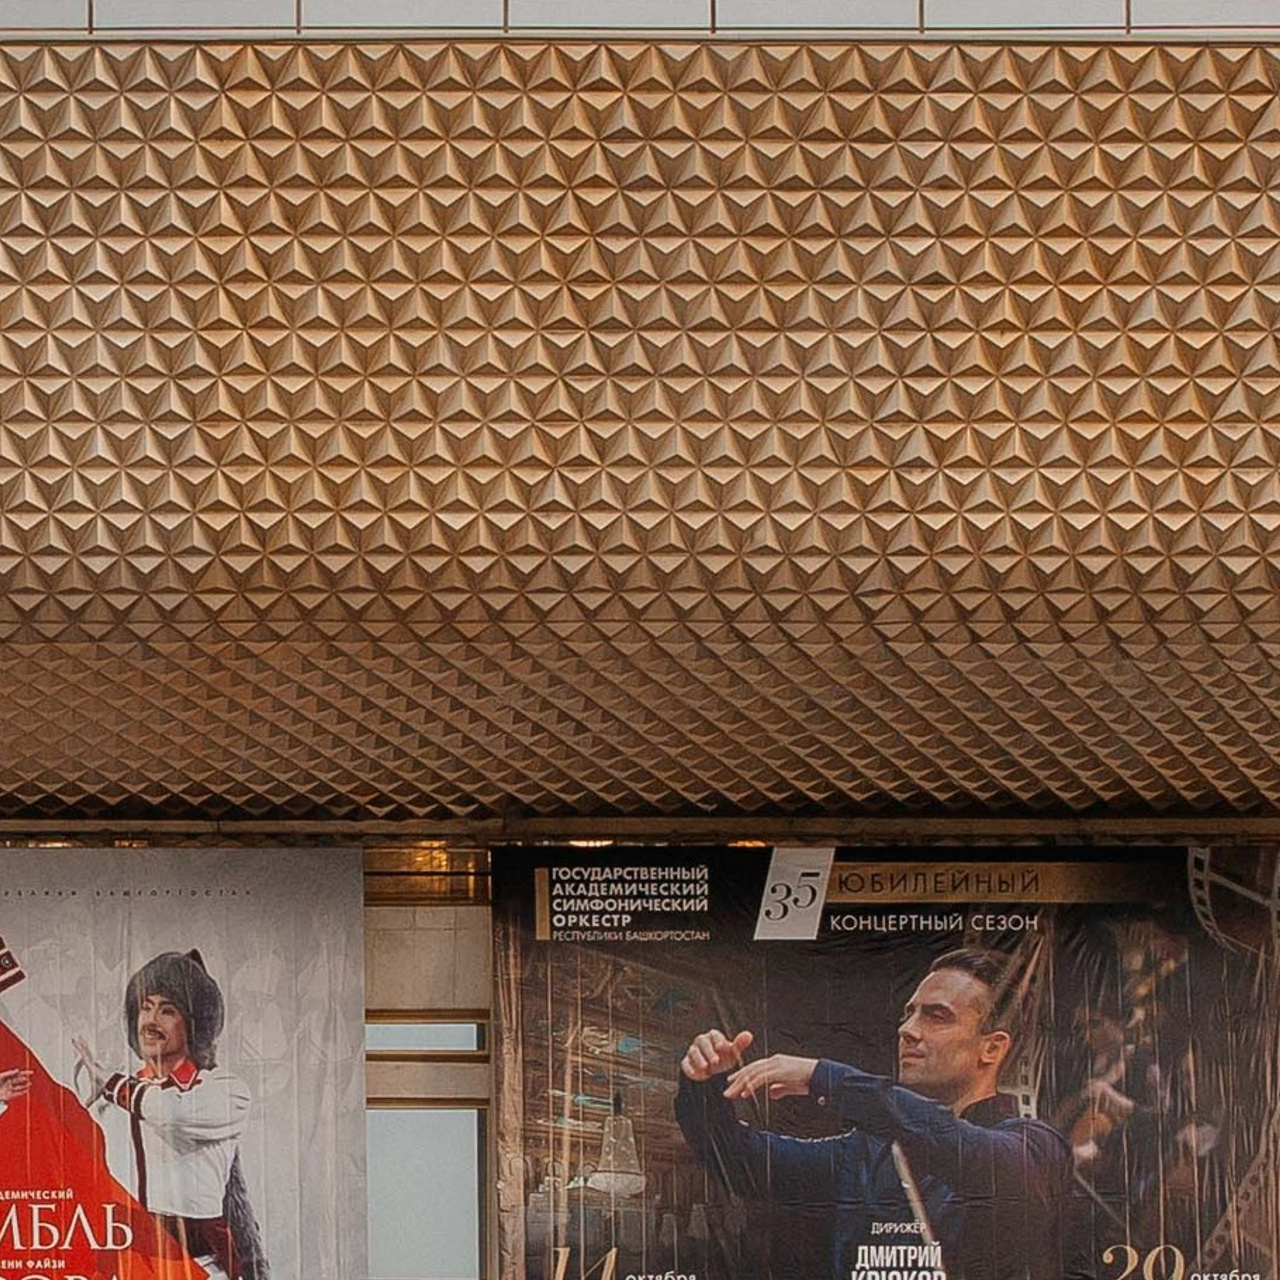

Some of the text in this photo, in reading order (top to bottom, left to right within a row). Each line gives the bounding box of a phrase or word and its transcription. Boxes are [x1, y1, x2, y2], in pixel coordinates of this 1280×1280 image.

[552, 864, 709, 882] ГОСУДАРСТВЕННЫЙ
[838, 869, 1040, 894] ЮБИЛЕЙНЫЙ
[552, 880, 709, 897] АКАДЕМИЧЕСКИЙ
[764, 871, 821, 922] 35
[552, 896, 709, 912] СИМФОНИЧЕСКИЙ
[552, 914, 632, 928] ОРКЕСТР
[830, 912, 1039, 933] КОНЦЕРТНЫЙ СЕЗОН
[553, 930, 711, 942] РЕСПУБЛИКИ БАШКОРТОСТАН
[26, 1257, 66, 1270] ФАЙЗИ
[855, 1240, 943, 1270] ДМИТРИЙ
